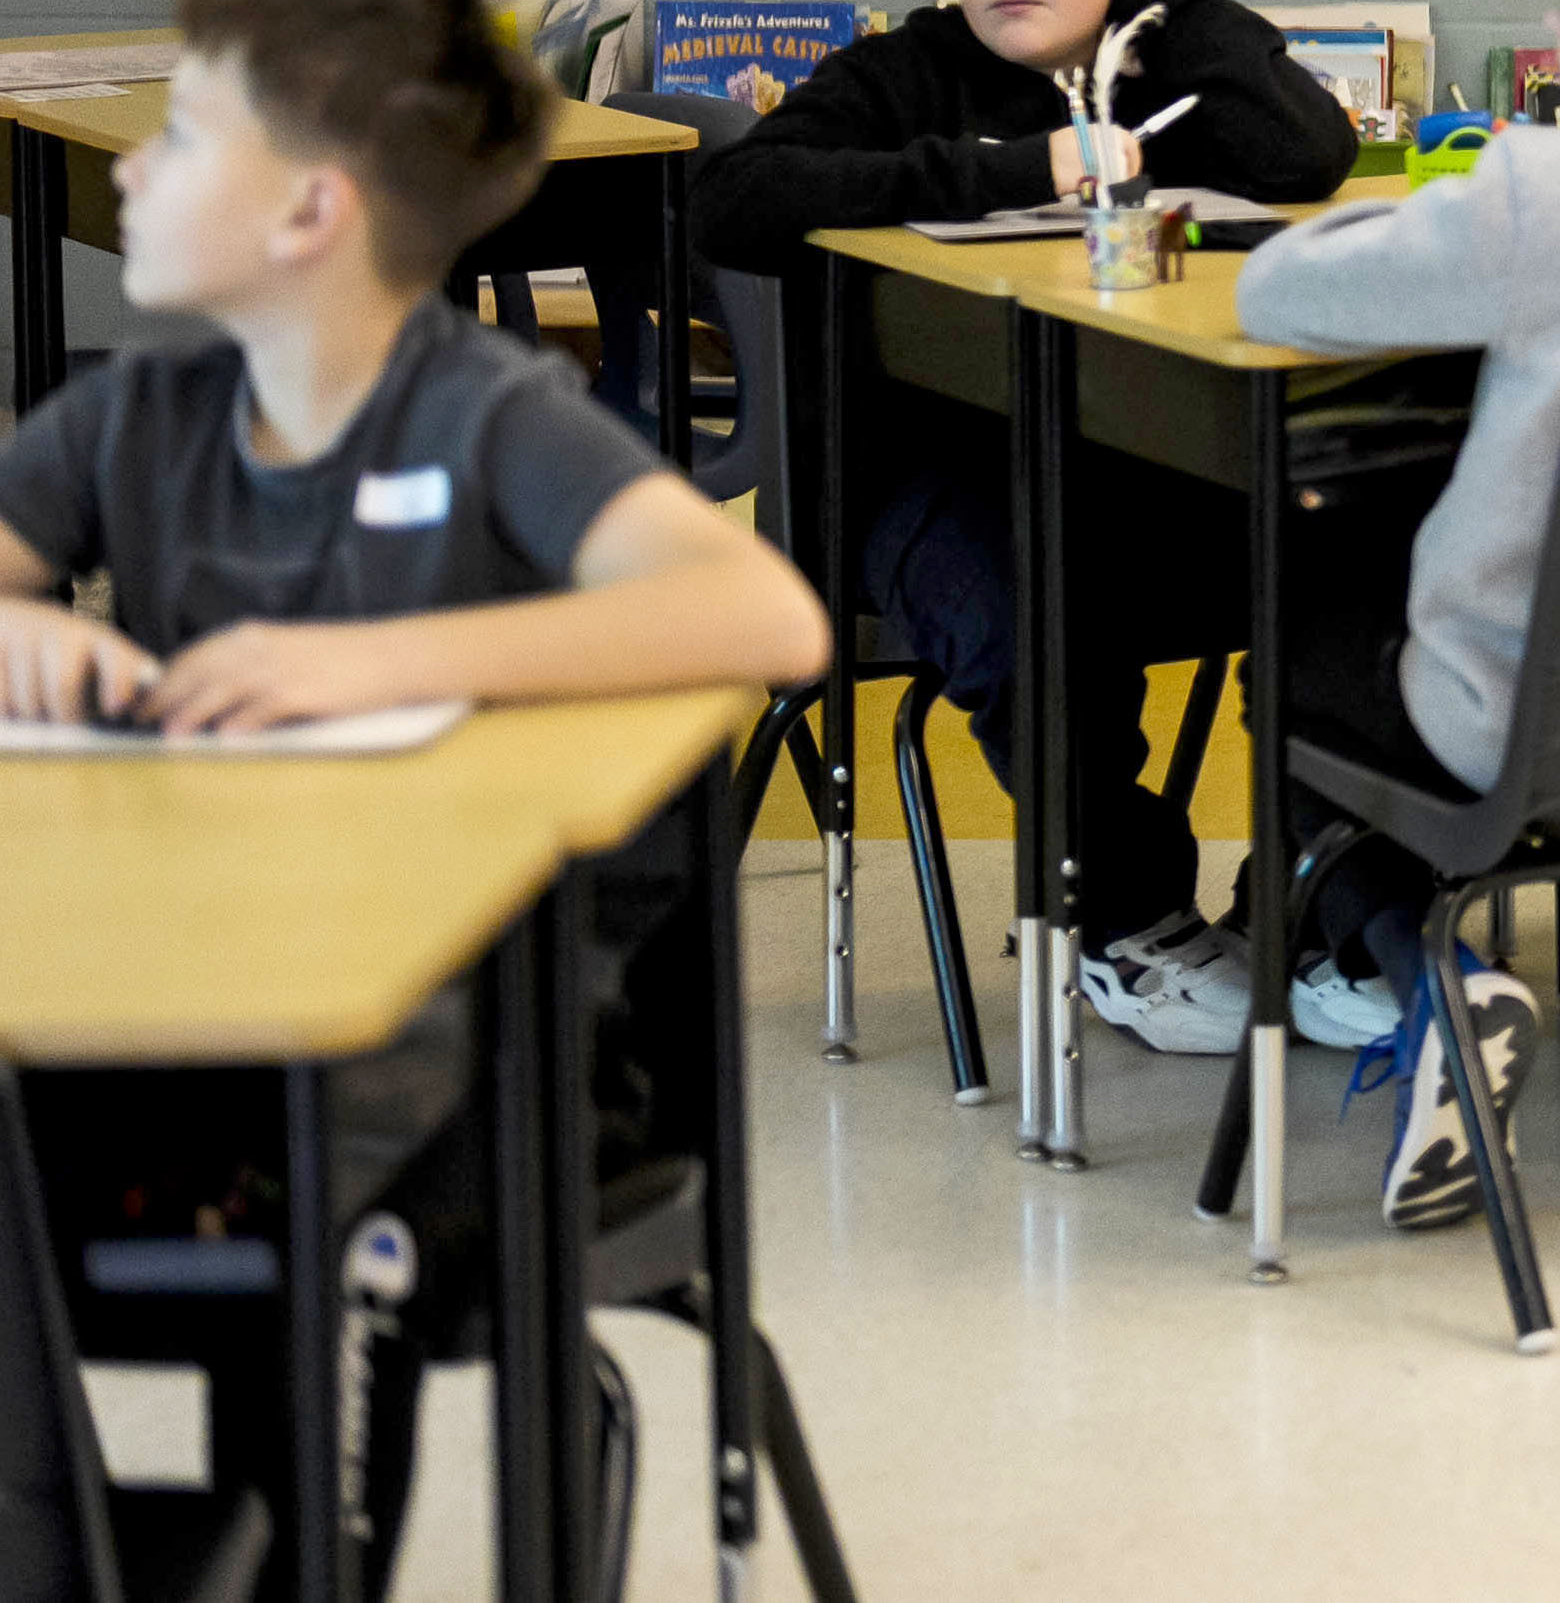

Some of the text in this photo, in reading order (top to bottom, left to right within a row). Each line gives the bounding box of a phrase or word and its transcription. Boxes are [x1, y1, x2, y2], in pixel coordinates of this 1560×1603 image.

[676, 12, 831, 29] Ms. Frizzle's Adventures
[663, 33, 843, 66] MEDIEVAL CASTL
